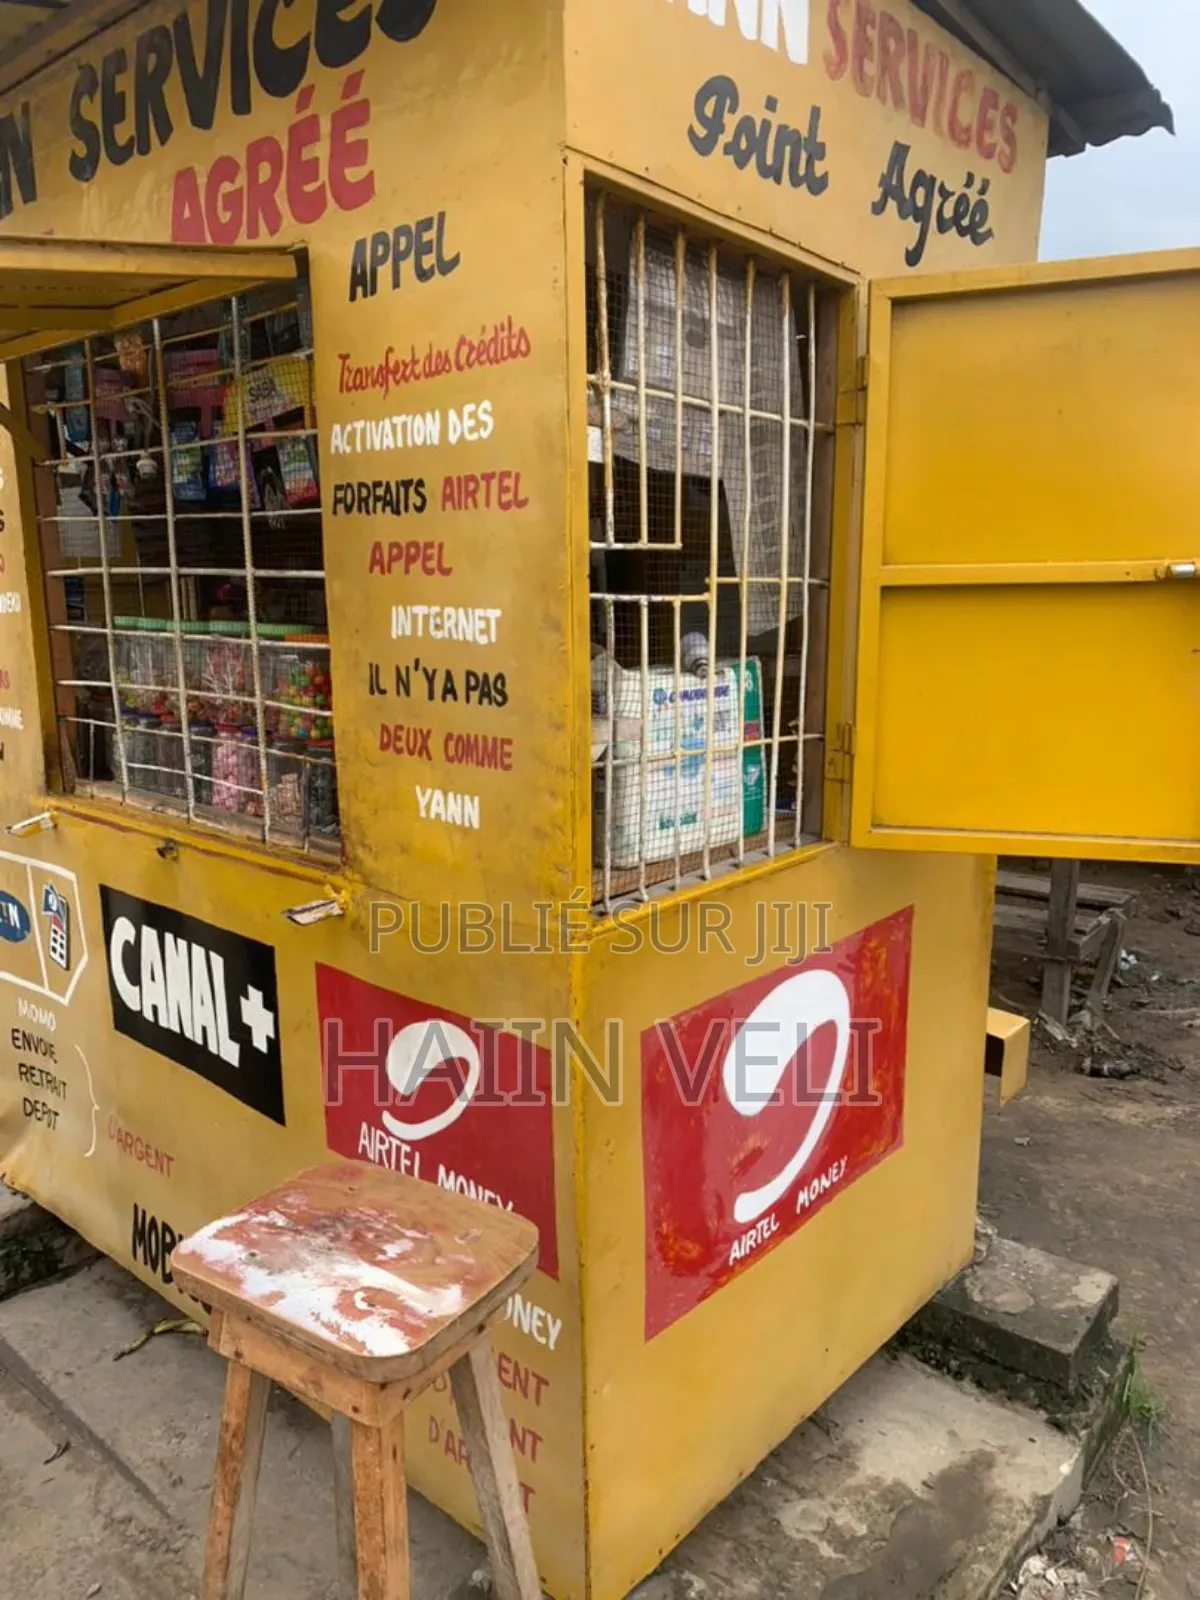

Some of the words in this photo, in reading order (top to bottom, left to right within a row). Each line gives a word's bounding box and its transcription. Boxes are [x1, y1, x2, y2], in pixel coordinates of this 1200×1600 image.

[822, 0, 1018, 174] SERVICES
[171, 69, 376, 245] AGRÉÉ
[688, 74, 829, 196] Point
[871, 139, 995, 268] Agréé
[348, 211, 460, 302] APPEL
[338, 345, 421, 400] Transfert
[423, 342, 452, 379] des
[454, 315, 531, 371] Crédits
[331, 410, 440, 455] ACTIVATION
[447, 400, 494, 444] DES
[332, 478, 427, 516] FORFAITS
[441, 470, 530, 511] AIRTEL
[368, 541, 453, 576] APPEL
[391, 605, 502, 645] INTERNET
[368, 662, 388, 695] IL
[465, 670, 509, 707] PAS
[378, 723, 432, 761] DEUX
[443, 732, 514, 772] COMME
[415, 785, 481, 829] YANN
[728, 1212, 780, 1266] AIRTEL
[796, 1155, 848, 1214] MONEY
